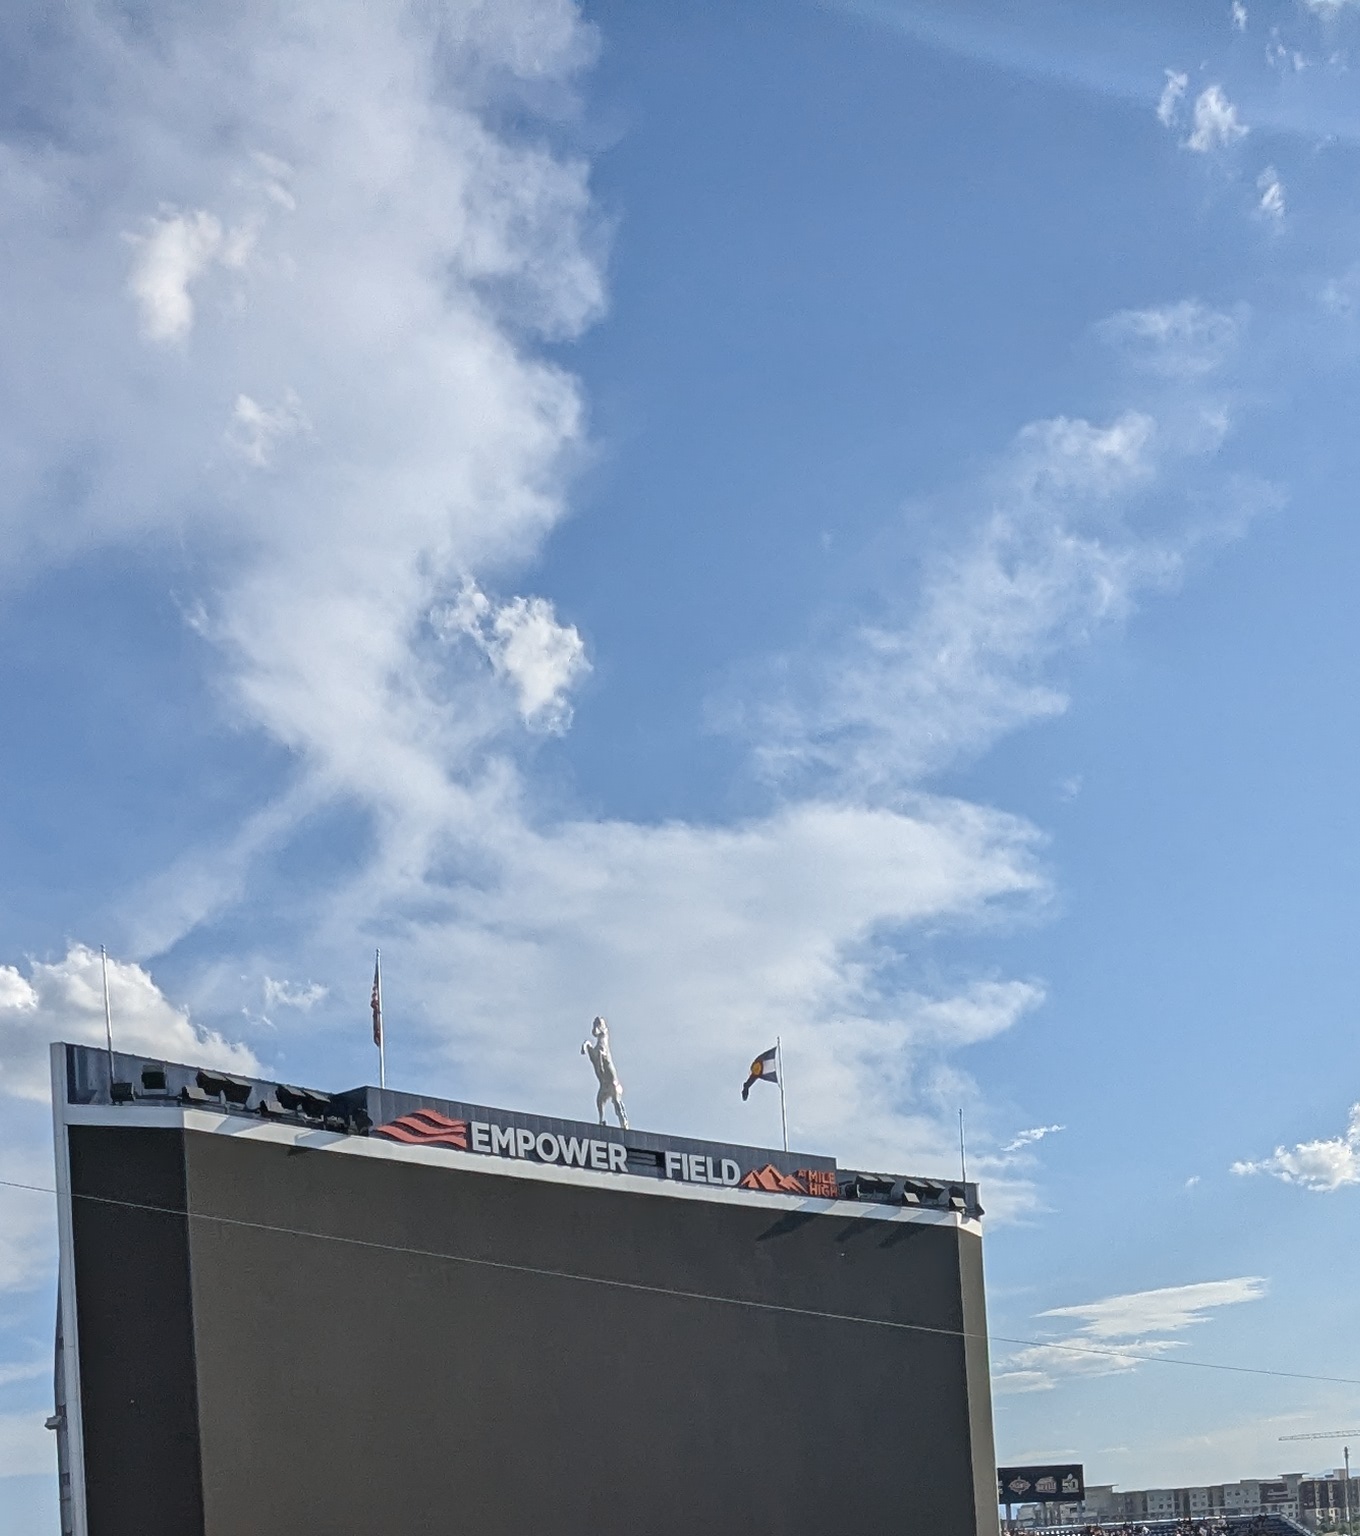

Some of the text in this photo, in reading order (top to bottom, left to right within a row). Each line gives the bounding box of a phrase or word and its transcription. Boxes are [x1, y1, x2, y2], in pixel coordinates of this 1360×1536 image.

[470, 1120, 741, 1186] EMPOWER FIELD
[808, 1169, 836, 1184] MILE
[809, 1183, 839, 1197] HIGH
